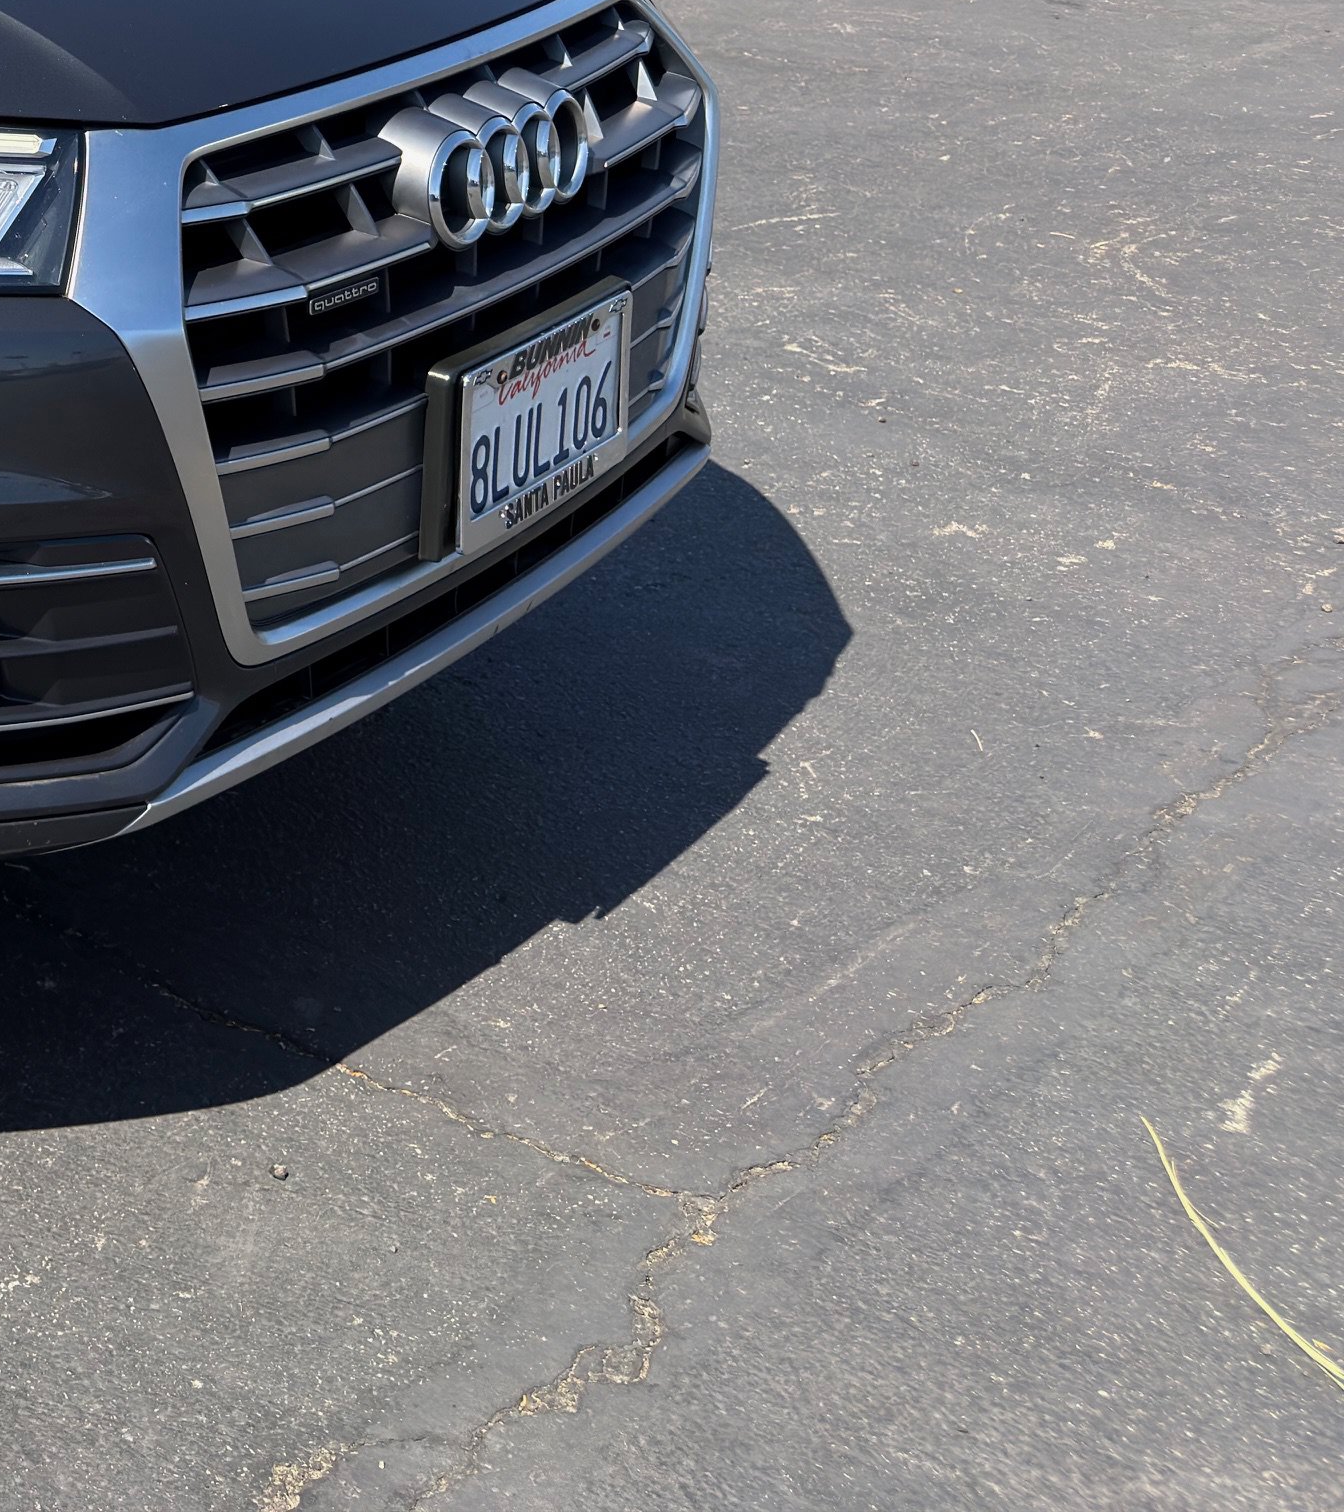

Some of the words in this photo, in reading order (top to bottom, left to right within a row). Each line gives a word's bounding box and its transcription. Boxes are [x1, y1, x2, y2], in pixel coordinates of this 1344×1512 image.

[314, 281, 377, 311] quattro
[498, 339, 596, 406] California
[509, 312, 595, 379] BUNNIN
[470, 360, 612, 515] 8LUL106
